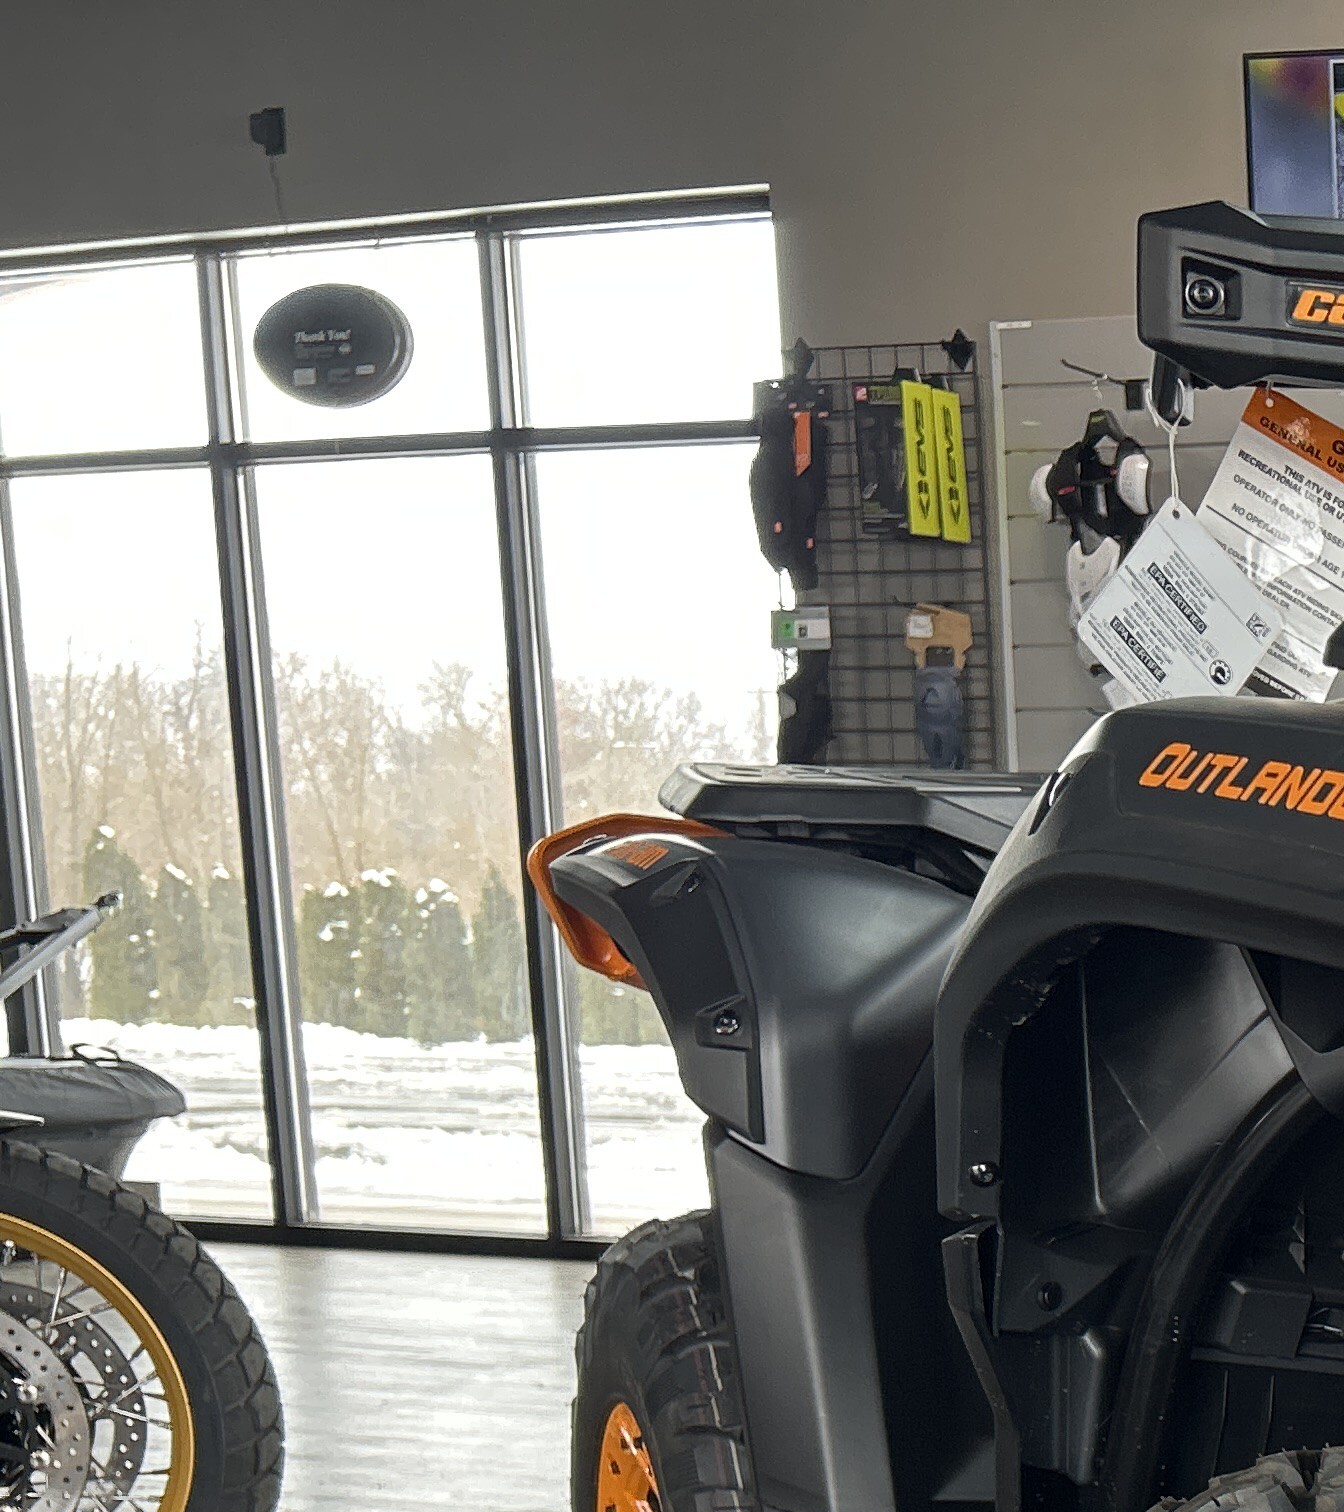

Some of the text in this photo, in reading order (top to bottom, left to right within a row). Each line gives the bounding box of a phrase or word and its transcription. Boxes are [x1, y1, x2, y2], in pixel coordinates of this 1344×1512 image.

[1257, 415, 1325, 461] GENERAL
[1231, 473, 1279, 507] OPERATOR
[1236, 449, 1302, 494] RECREATIONAL
[1321, 501, 1337, 515] OR
[1281, 464, 1305, 483] THIS
[1303, 478, 1323, 494] ATV
[1321, 489, 1333, 501] IS
[1230, 502, 1246, 516] NO
[1320, 558, 1340, 575] AGE
[1148, 565, 1168, 586] EPA
[1163, 582, 1206, 632] CERTIFIED
